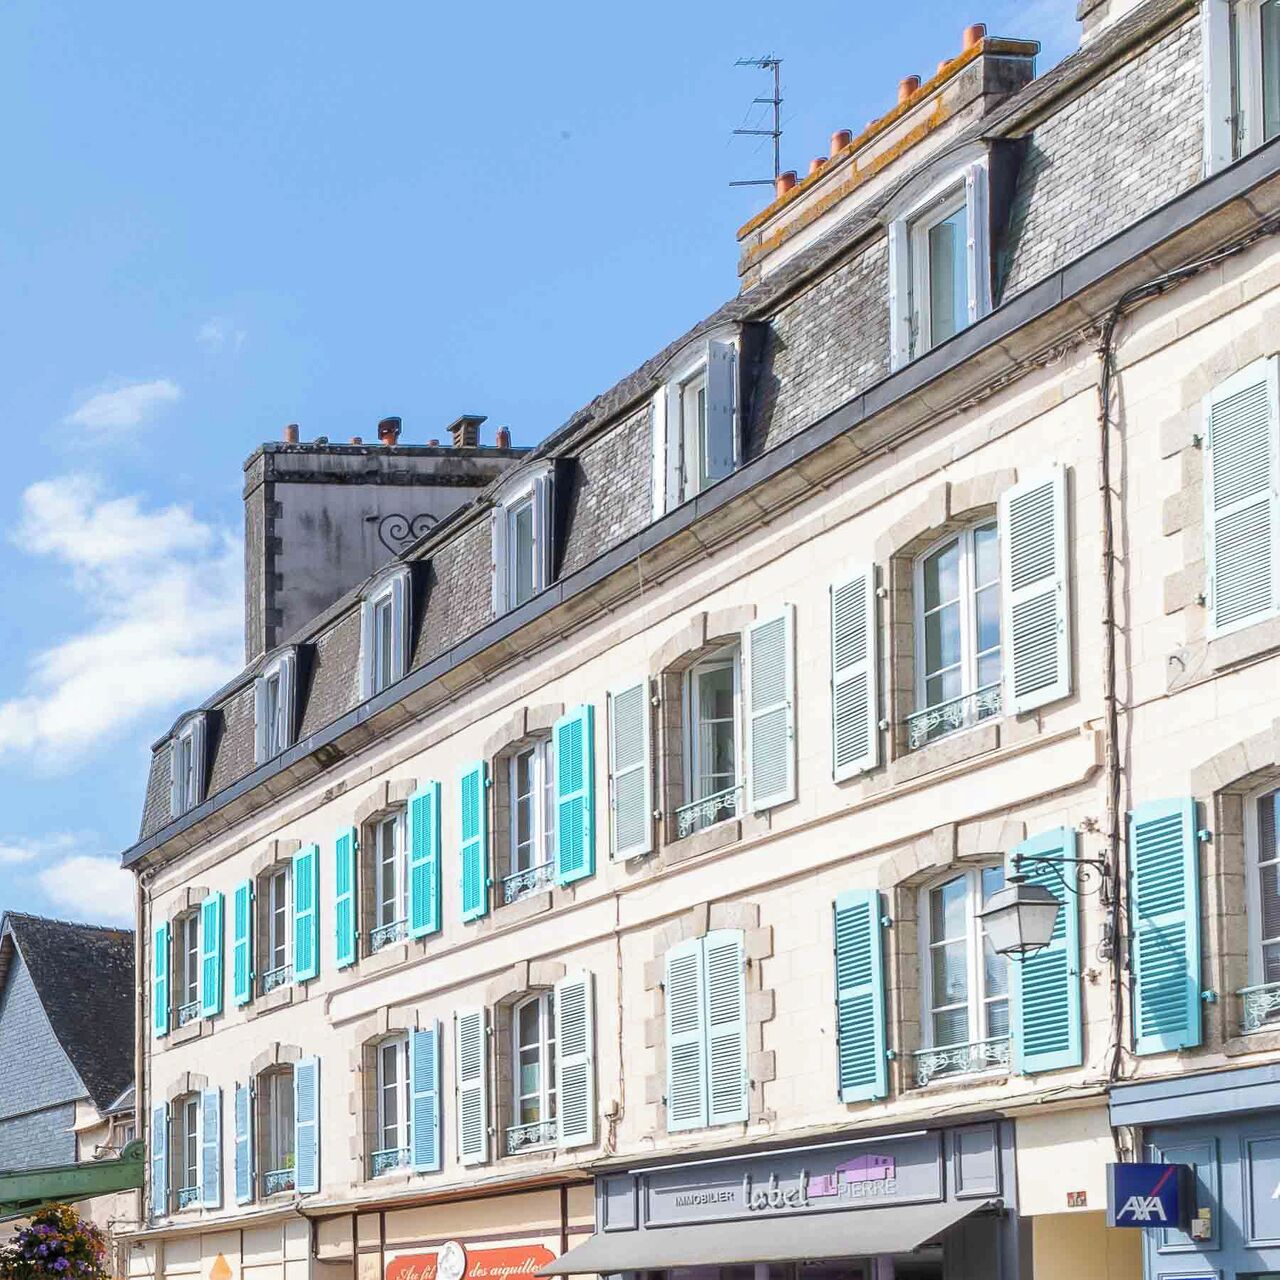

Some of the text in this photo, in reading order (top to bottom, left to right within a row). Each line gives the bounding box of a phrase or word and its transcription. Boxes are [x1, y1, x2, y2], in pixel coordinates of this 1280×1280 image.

[675, 1168, 897, 1211] IMMOBILIER label PIERRE
[1116, 1196, 1167, 1221] AXA
[469, 1262, 487, 1278] des
